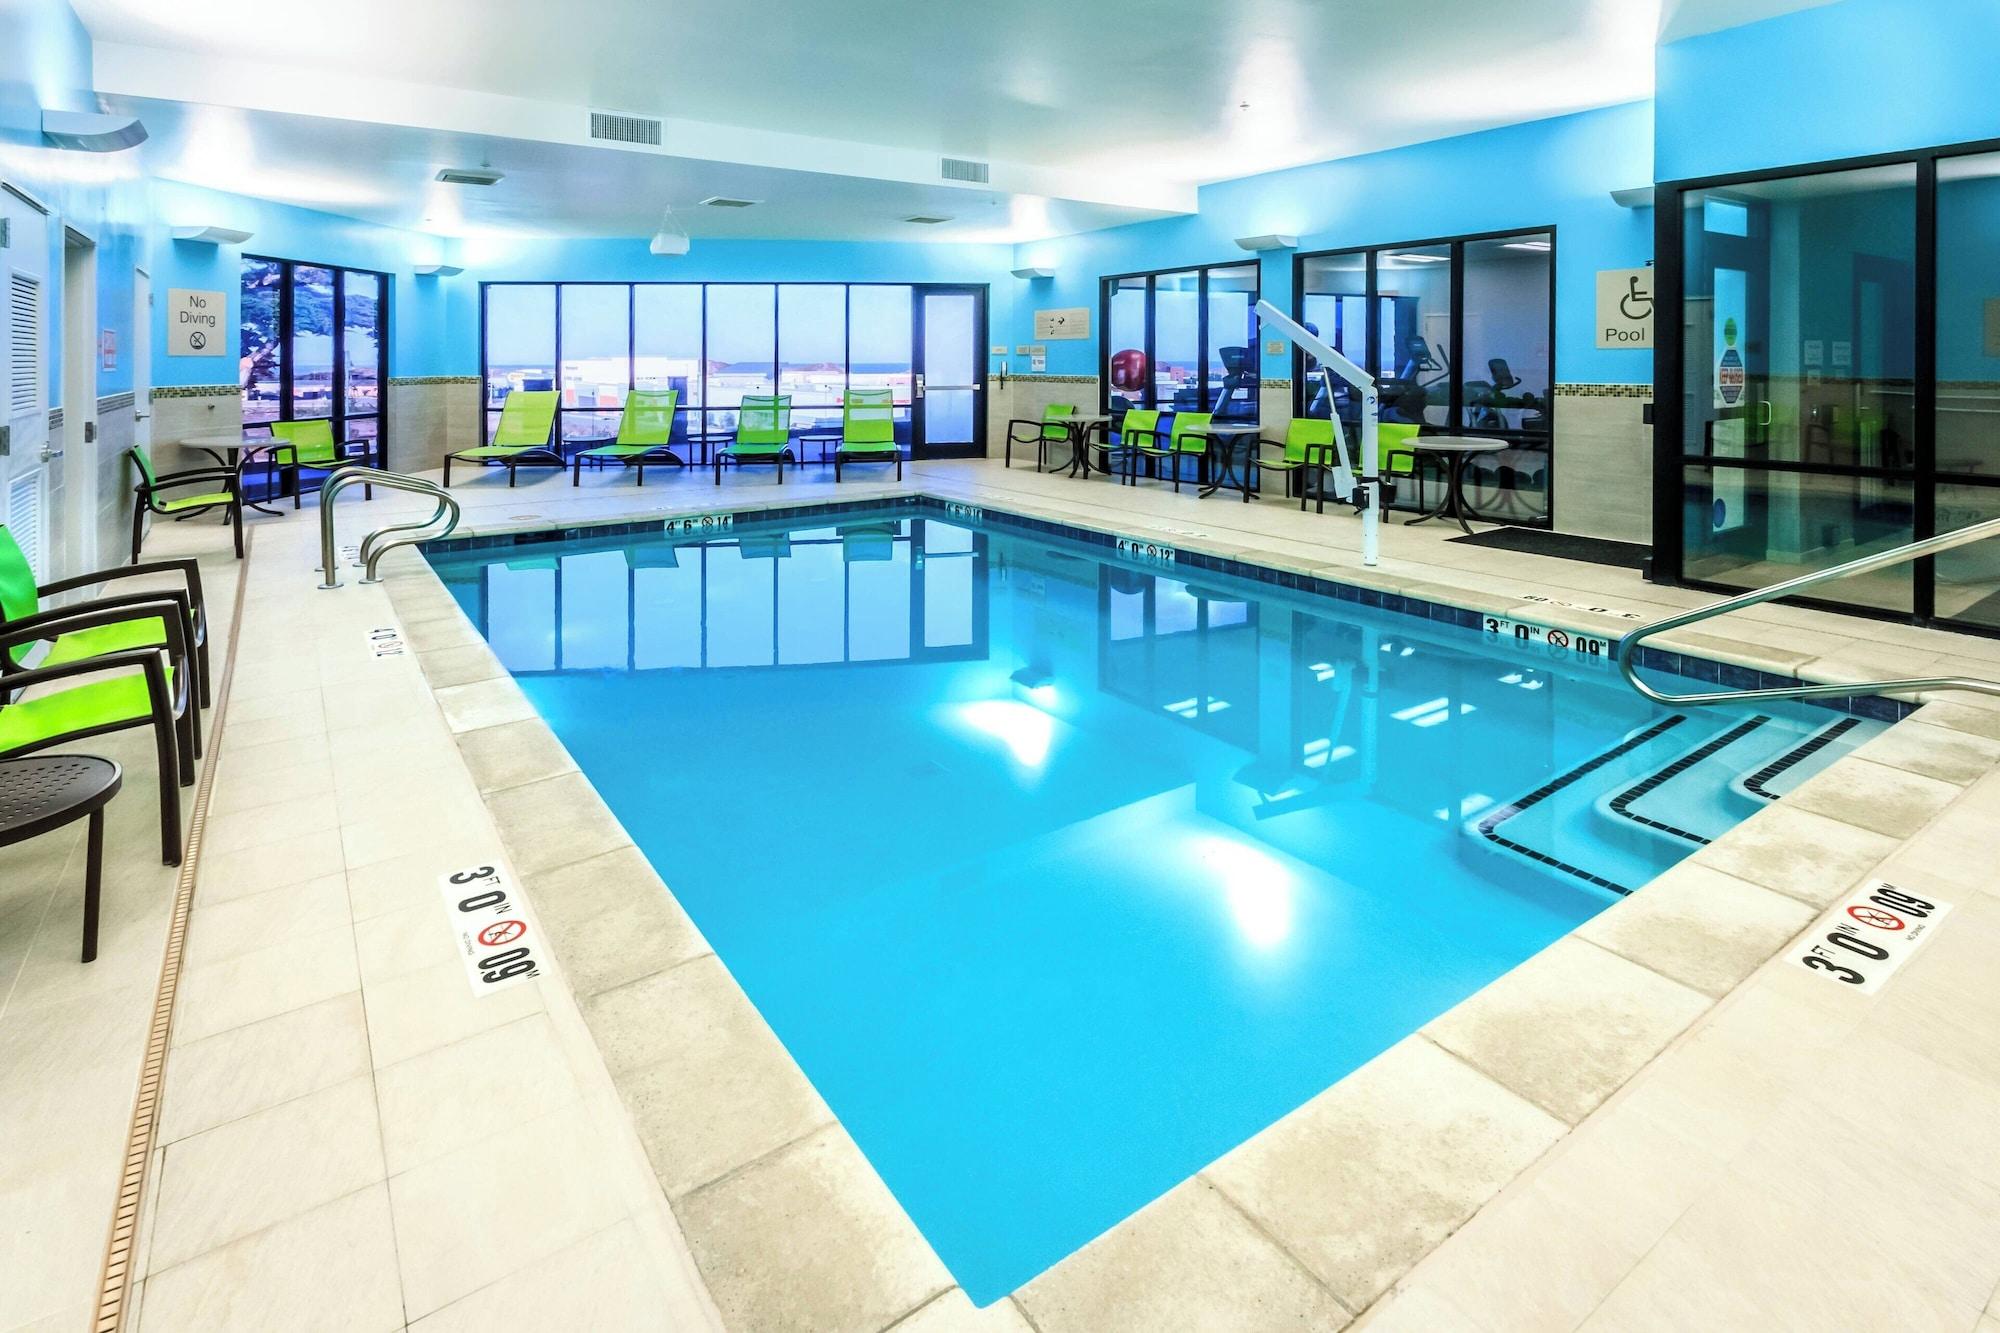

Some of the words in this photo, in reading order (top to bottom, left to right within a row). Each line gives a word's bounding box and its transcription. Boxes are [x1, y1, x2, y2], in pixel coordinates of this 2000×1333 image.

[190, 296, 206, 308] No
[180, 311, 216, 327] Diving
[1606, 328, 1645, 341] Pool
